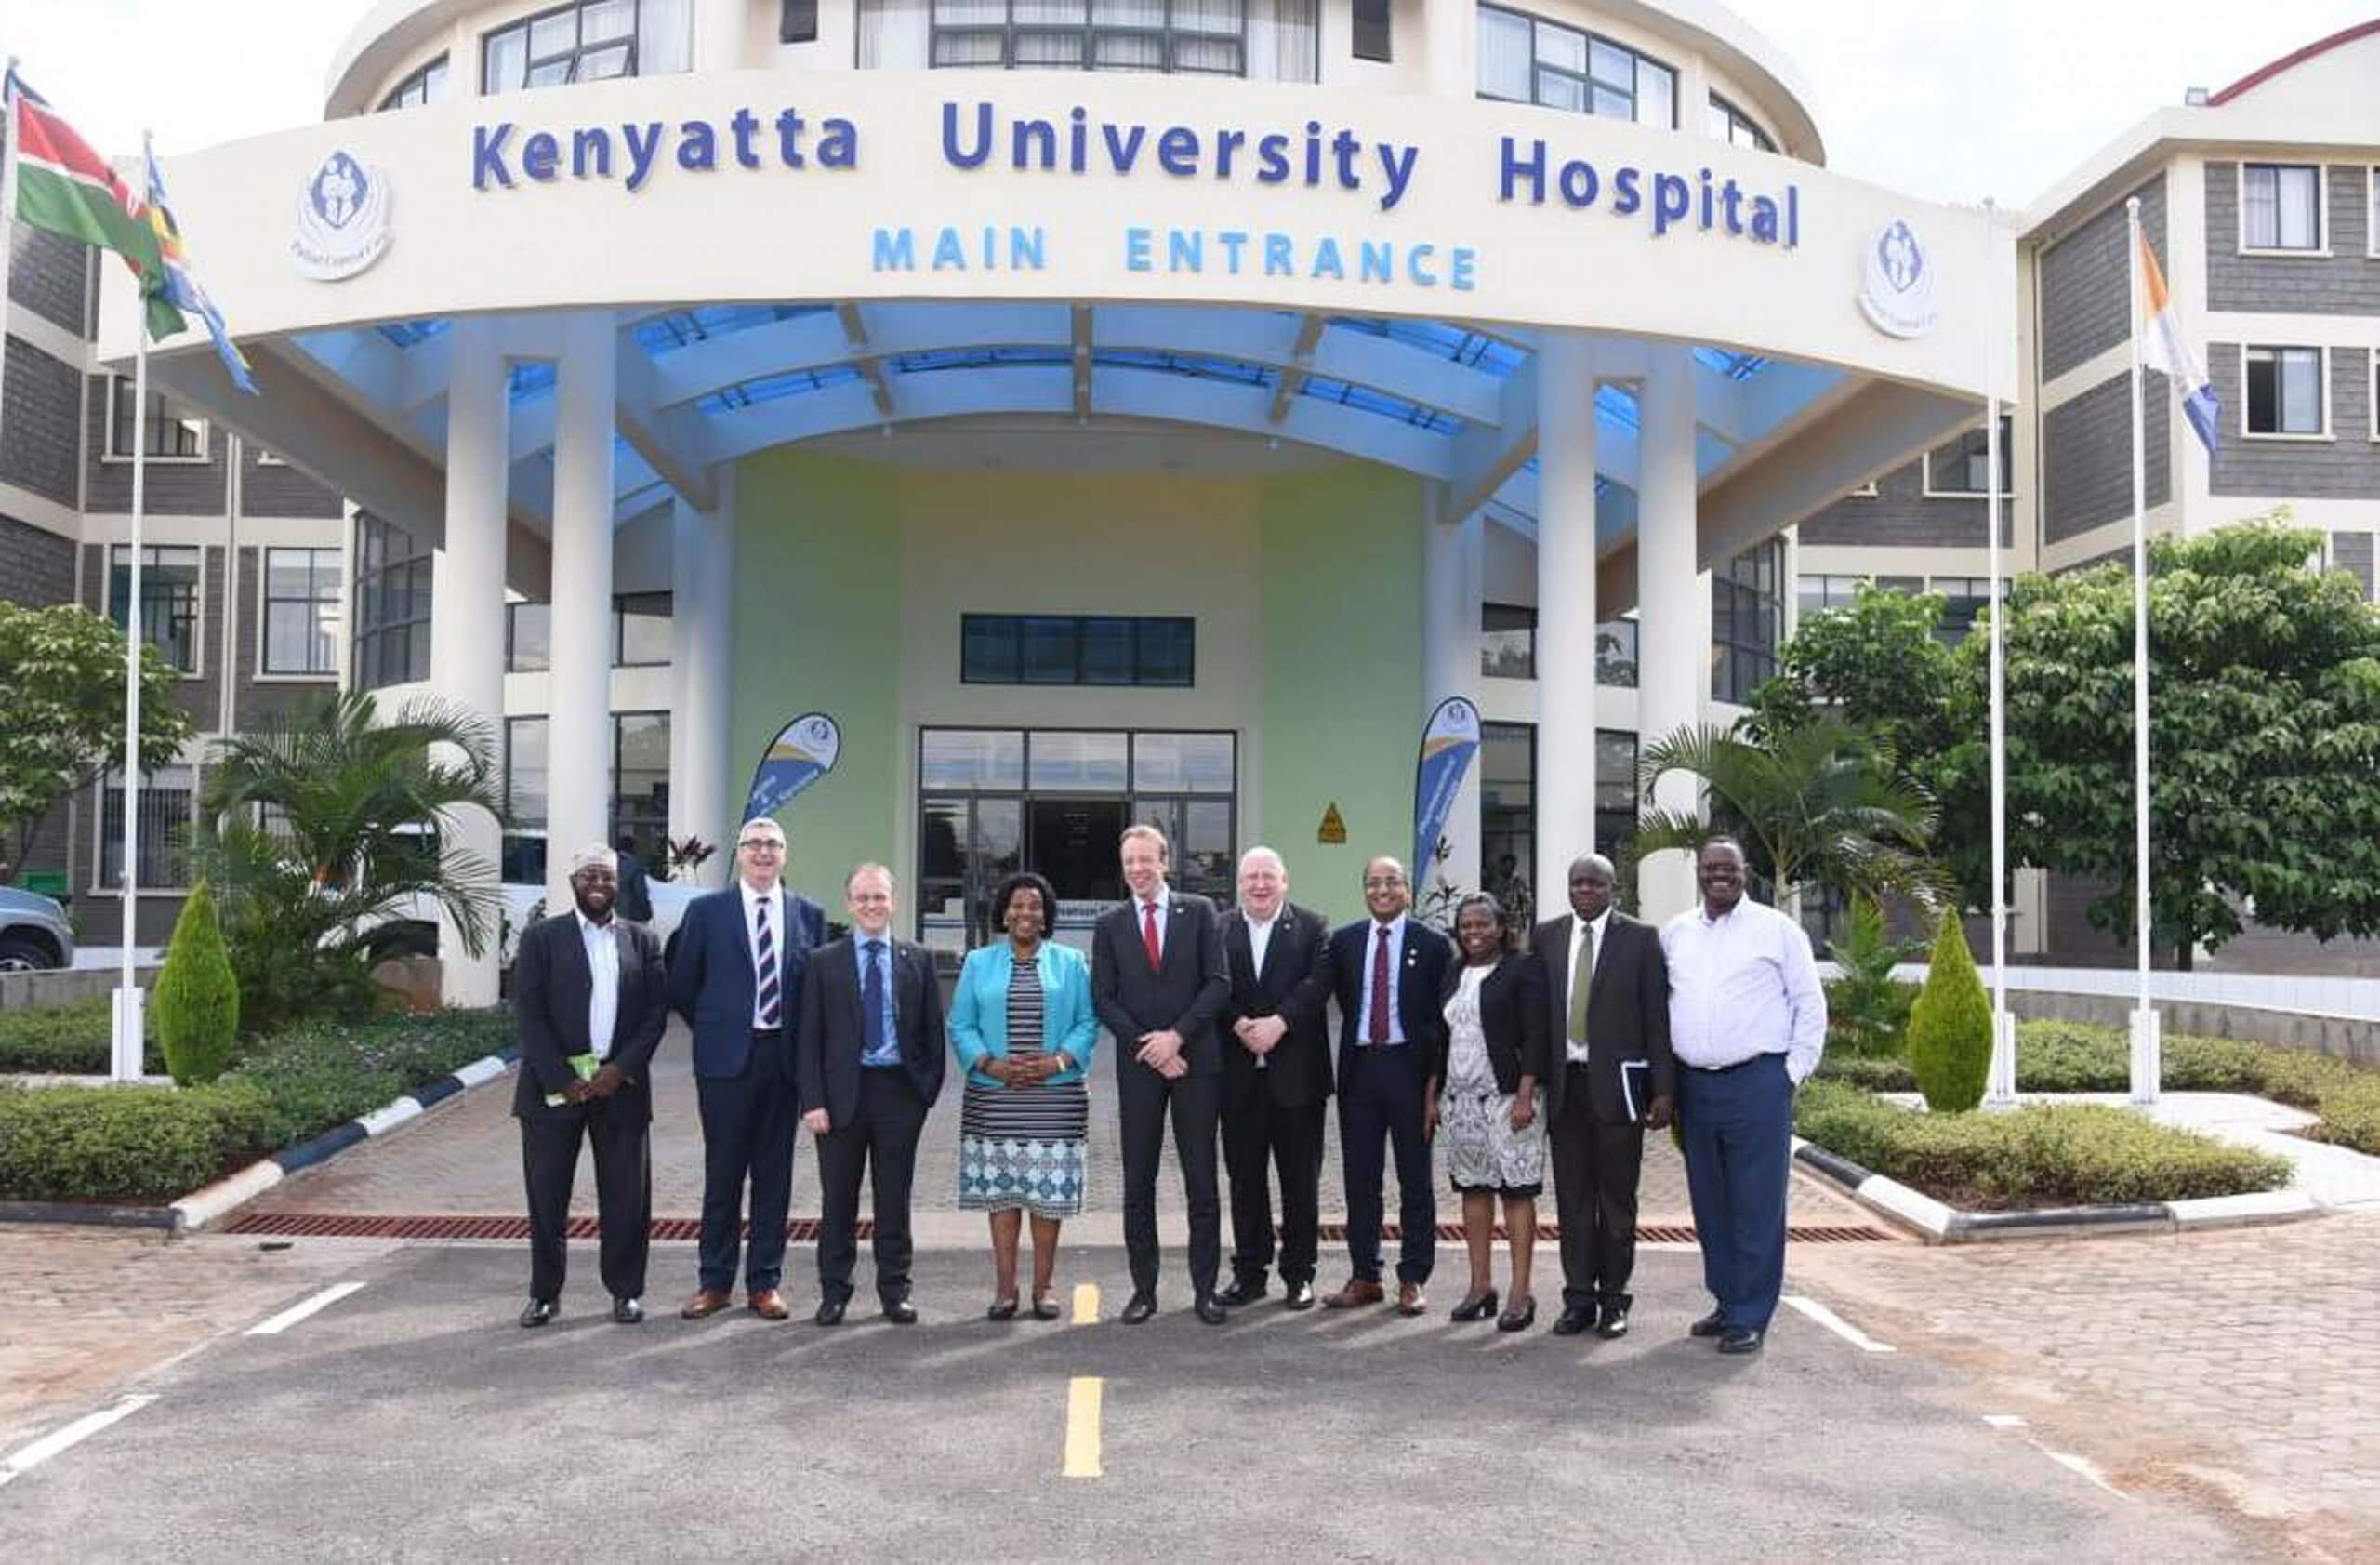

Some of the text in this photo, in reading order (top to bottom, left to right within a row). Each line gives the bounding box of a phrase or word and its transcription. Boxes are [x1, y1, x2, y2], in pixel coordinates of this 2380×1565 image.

[473, 102, 1800, 248] Kenyatta University Hospital
[871, 226, 1478, 290] MAIN ENTRANCE
